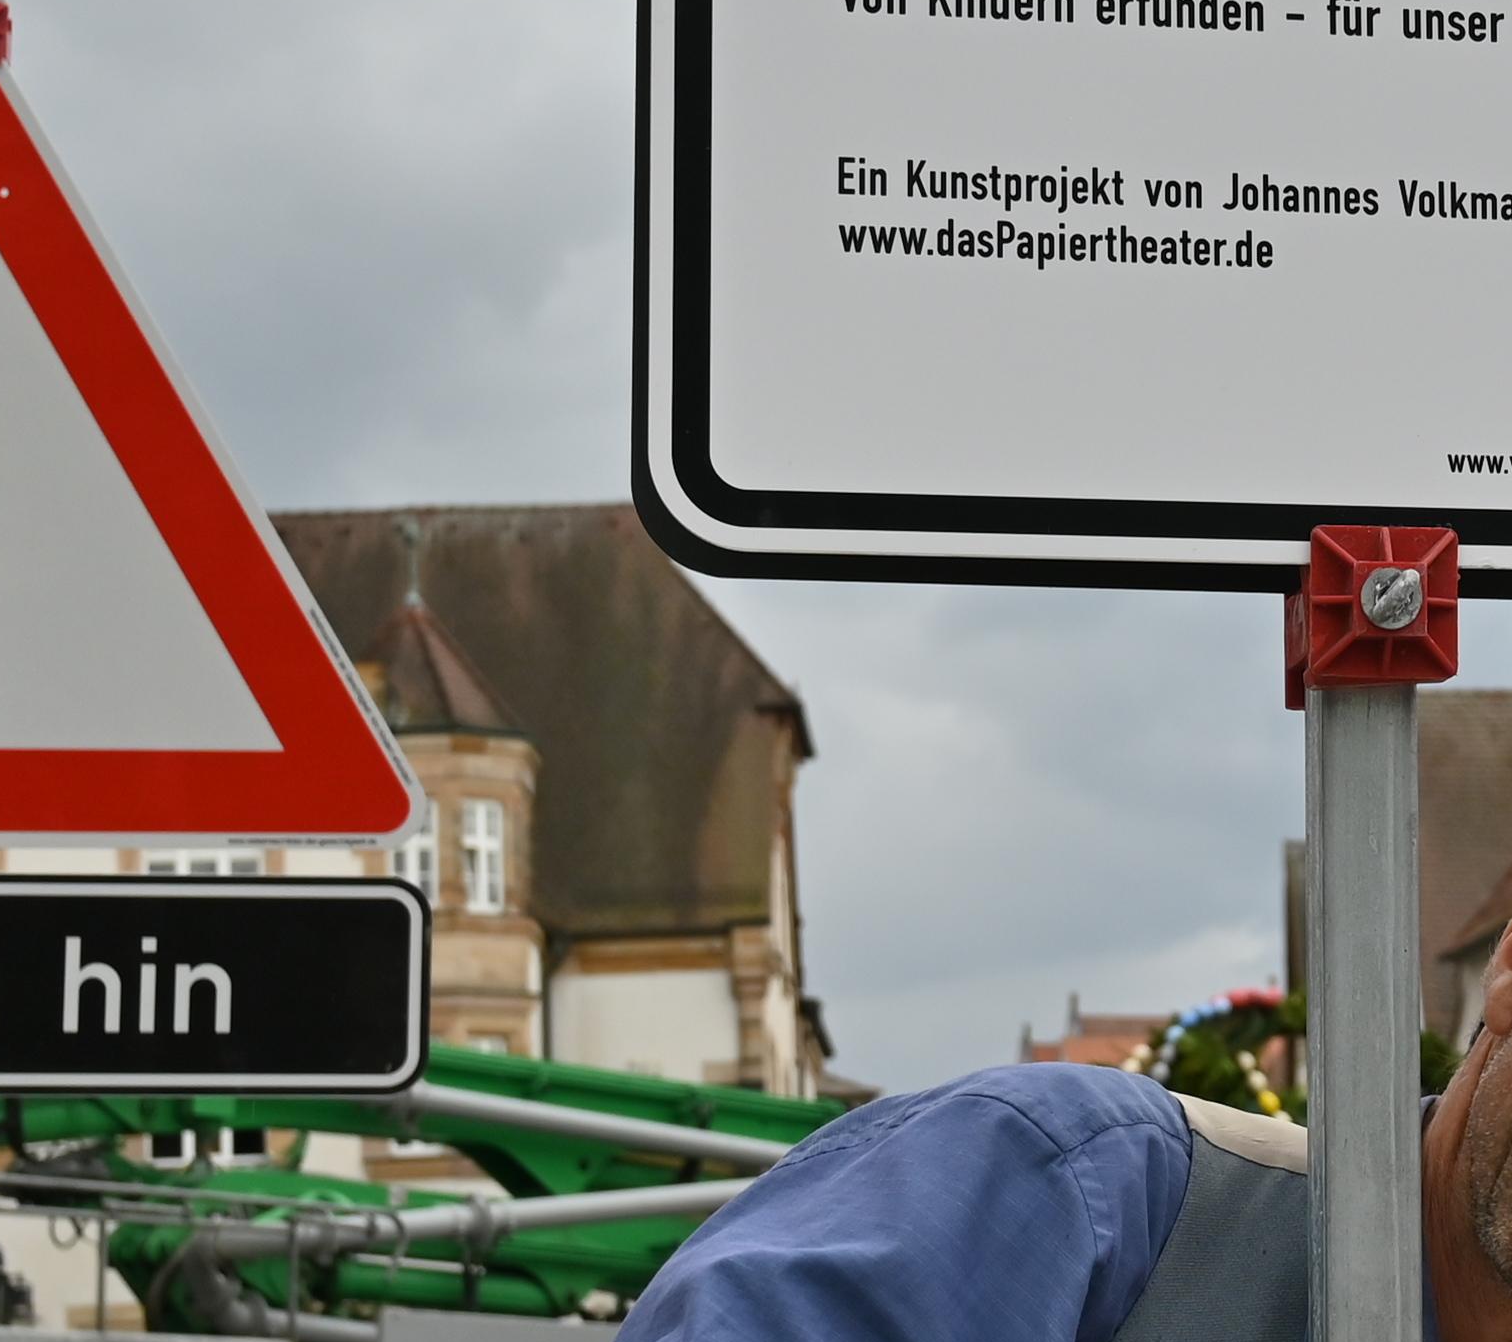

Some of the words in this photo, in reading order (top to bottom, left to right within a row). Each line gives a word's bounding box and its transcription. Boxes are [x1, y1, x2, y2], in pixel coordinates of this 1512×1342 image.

[1403, 9, 1504, 42] unser
[839, 157, 886, 196] Ein
[908, 160, 1123, 213] Kunstprojekt
[1145, 180, 1202, 208] von
[1223, 173, 1378, 215] Johannes
[839, 219, 1272, 270] www.dasPapiertheater.de
[63, 937, 231, 1033] hin
